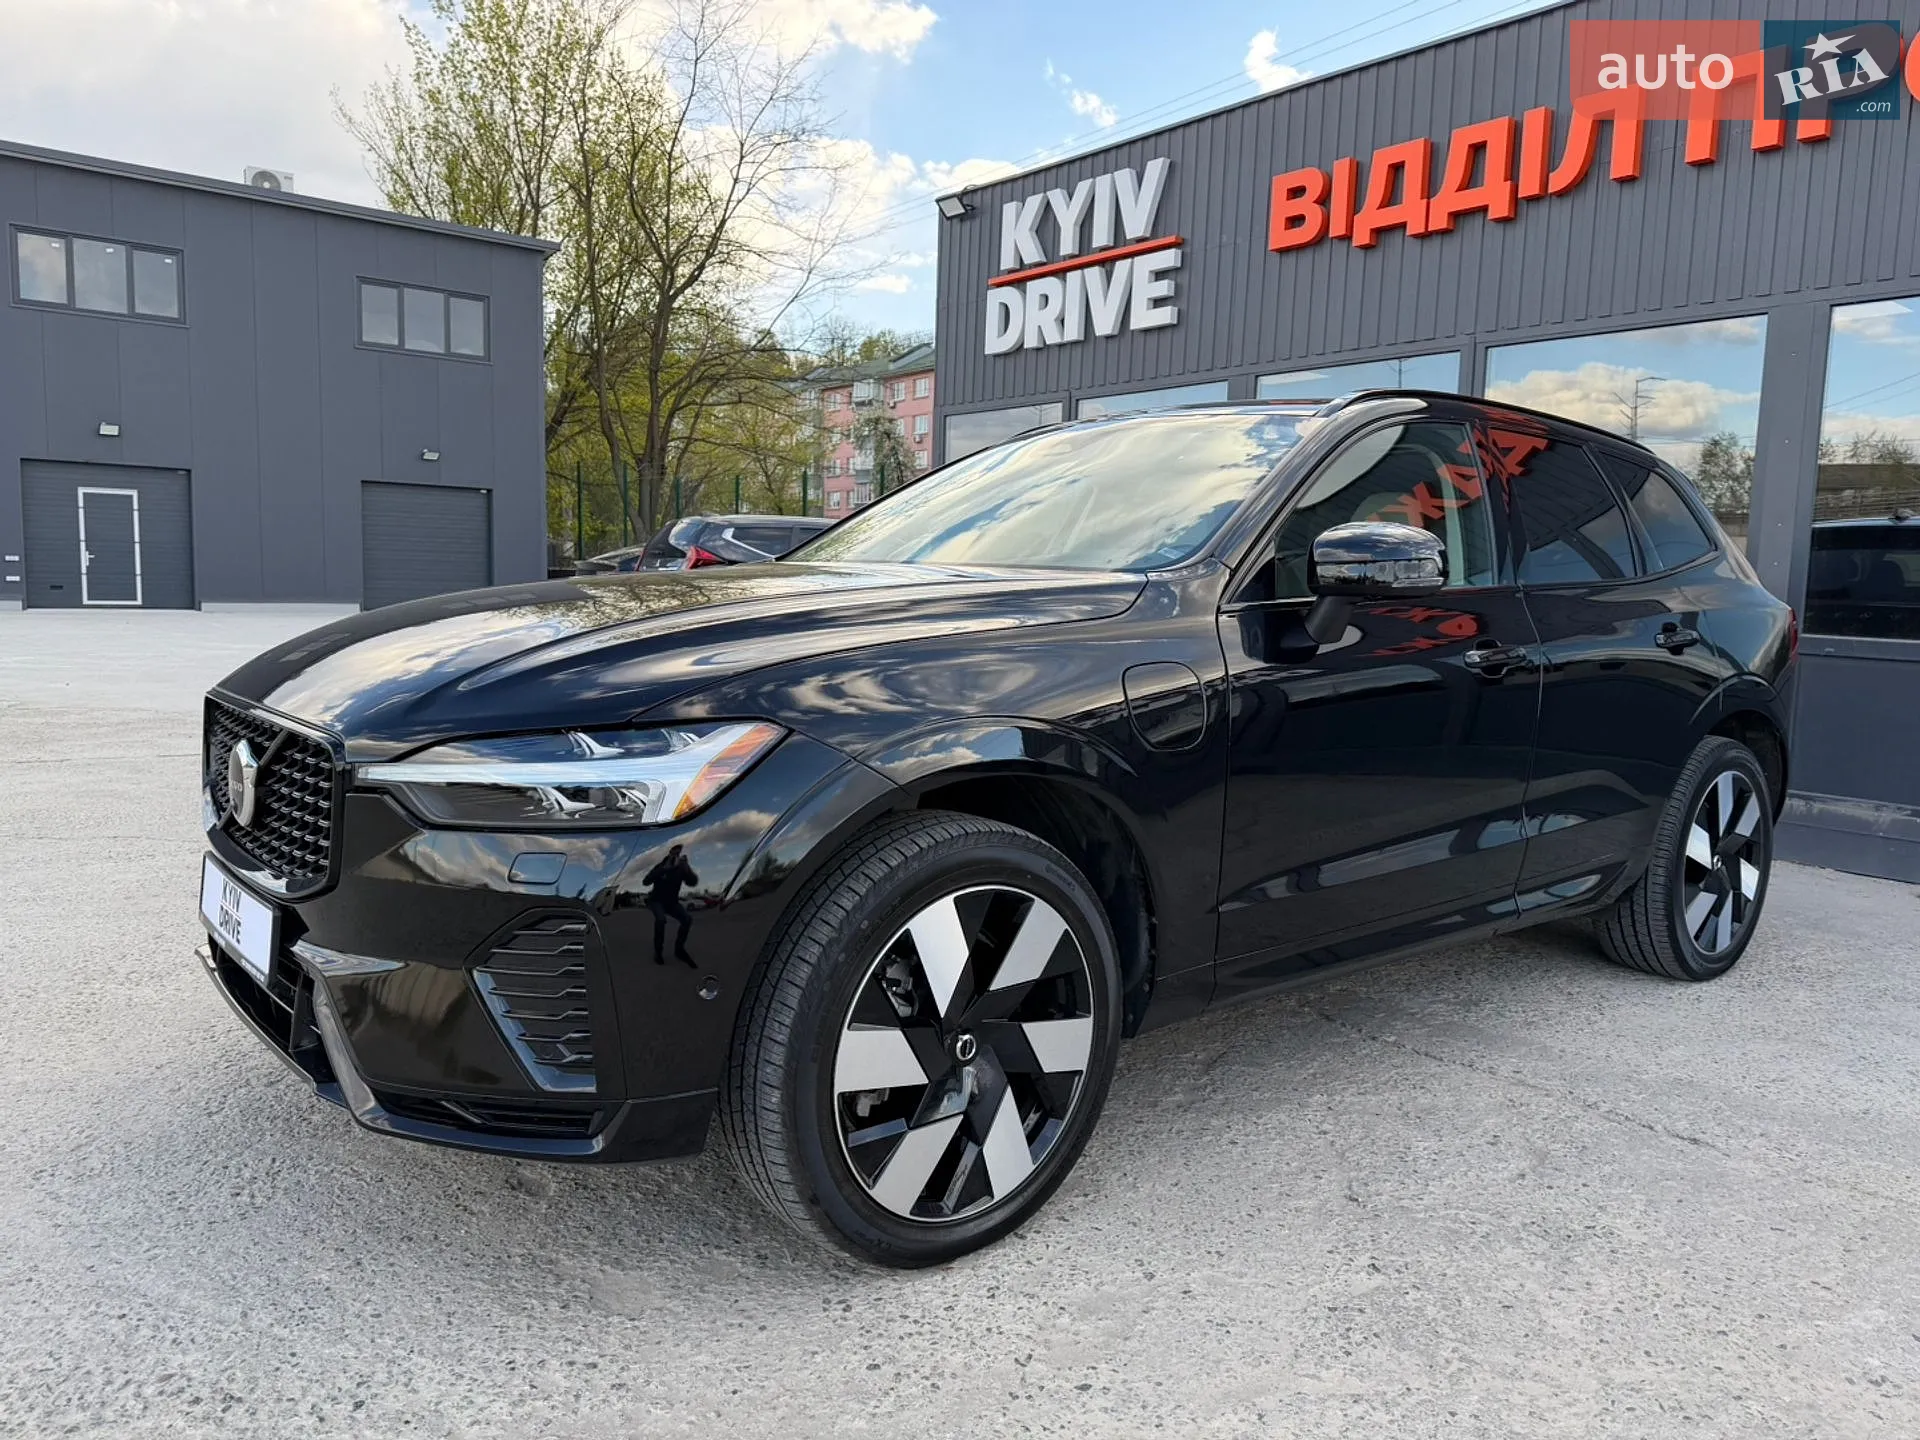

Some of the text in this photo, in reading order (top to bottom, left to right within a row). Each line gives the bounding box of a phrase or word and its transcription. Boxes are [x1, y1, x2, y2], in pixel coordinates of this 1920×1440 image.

[1268, 22, 1920, 253] ВІДДІЛ ПР
[1000, 157, 1171, 272] KYIV
[984, 248, 1183, 356] DRIVE
